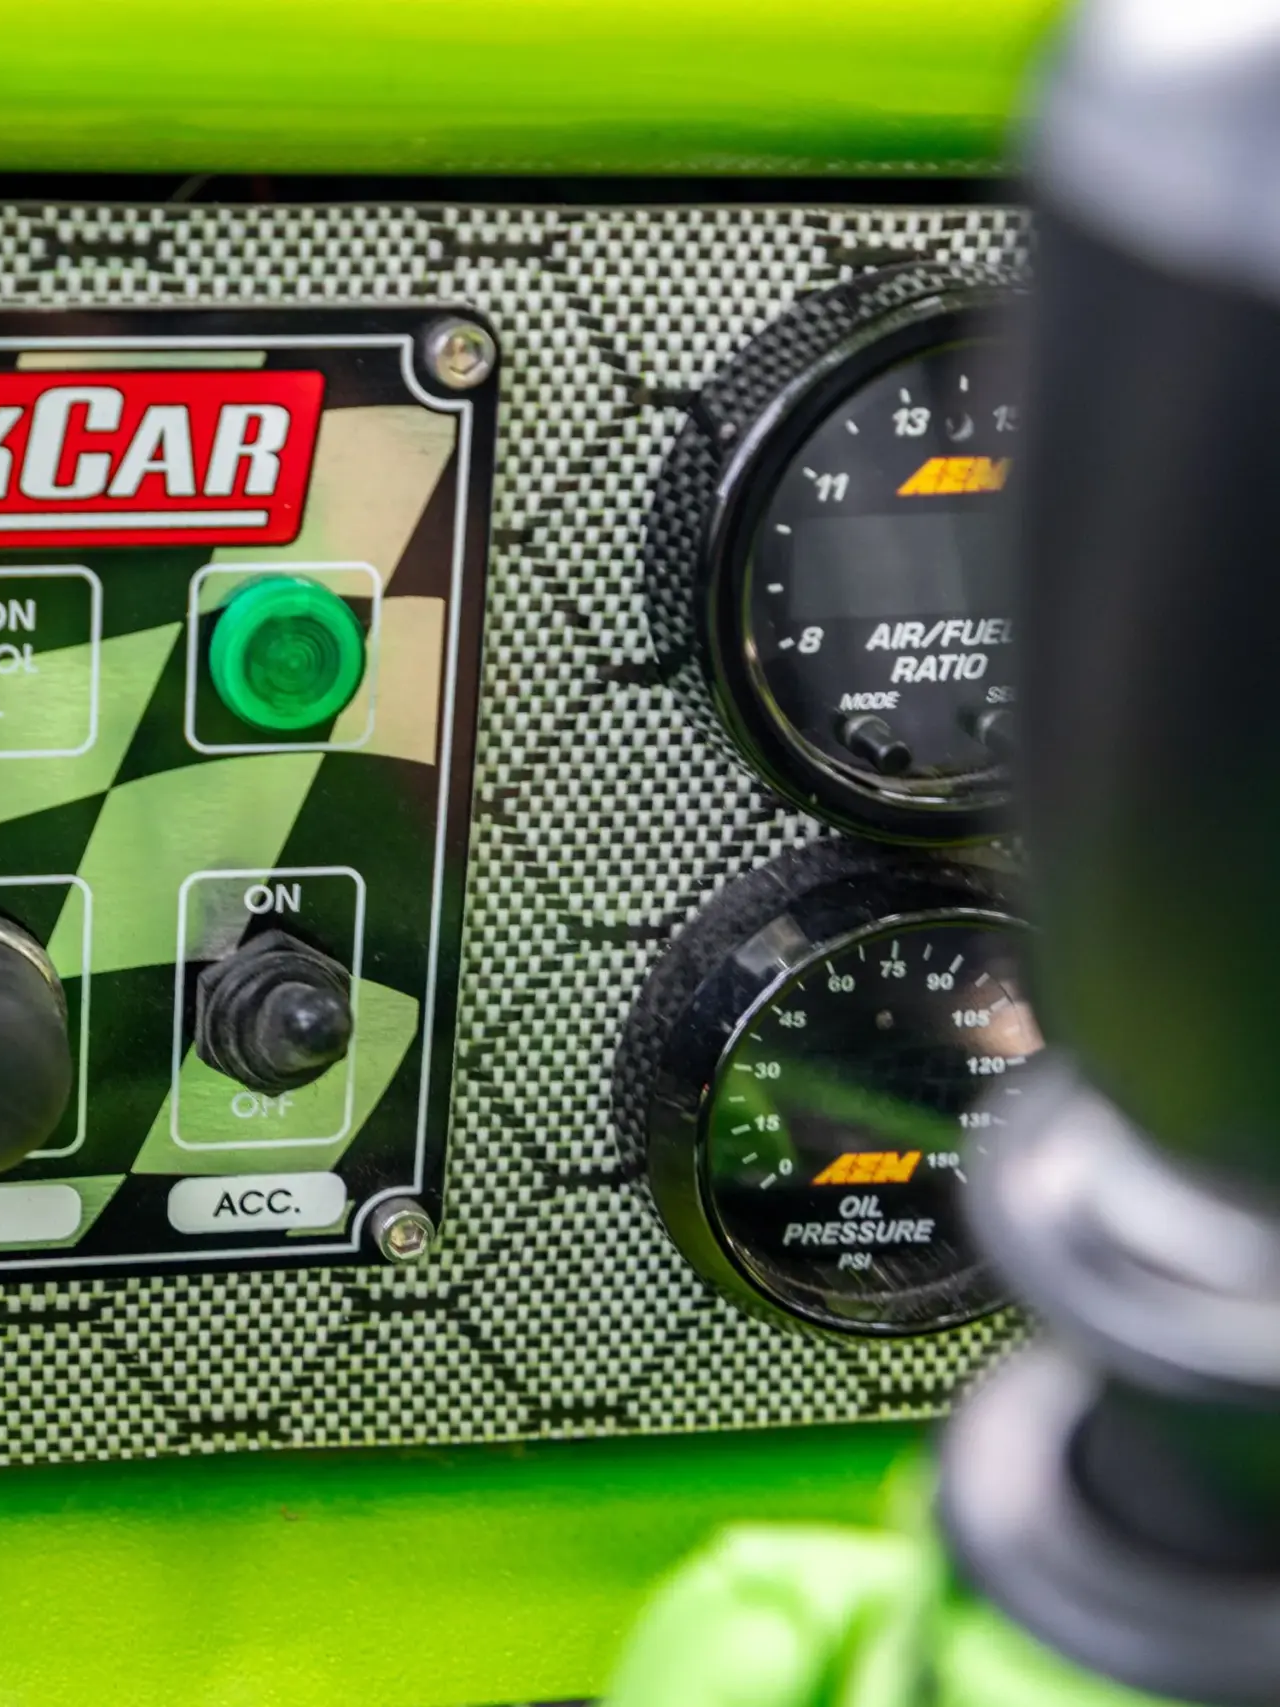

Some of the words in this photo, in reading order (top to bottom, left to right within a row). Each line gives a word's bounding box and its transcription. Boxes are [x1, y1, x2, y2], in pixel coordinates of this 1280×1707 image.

[892, 407, 930, 436] 13
[816, 472, 849, 501] 11
[797, 626, 825, 654] 8
[865, 618, 1012, 651] AIR/FUEL
[890, 652, 989, 684] RATIO
[839, 690, 901, 711] MODE
[244, 883, 302, 914] ON
[880, 961, 907, 979] 75
[828, 973, 855, 993] 60
[926, 972, 954, 991] 90
[779, 1012, 807, 1028] 45
[952, 1010, 990, 1028] 105
[754, 1063, 781, 1079] 30
[966, 1056, 1006, 1075] 120
[231, 1091, 295, 1119] OFF
[754, 1115, 781, 1132] 15
[778, 1159, 793, 1176] 0
[811, 1151, 922, 1186] AEM
[927, 1151, 960, 1169] 150
[213, 1189, 301, 1219] ACC.
[838, 1197, 883, 1218] OIL
[783, 1220, 934, 1246] PRESSURE
[838, 1252, 872, 1271] PSI
